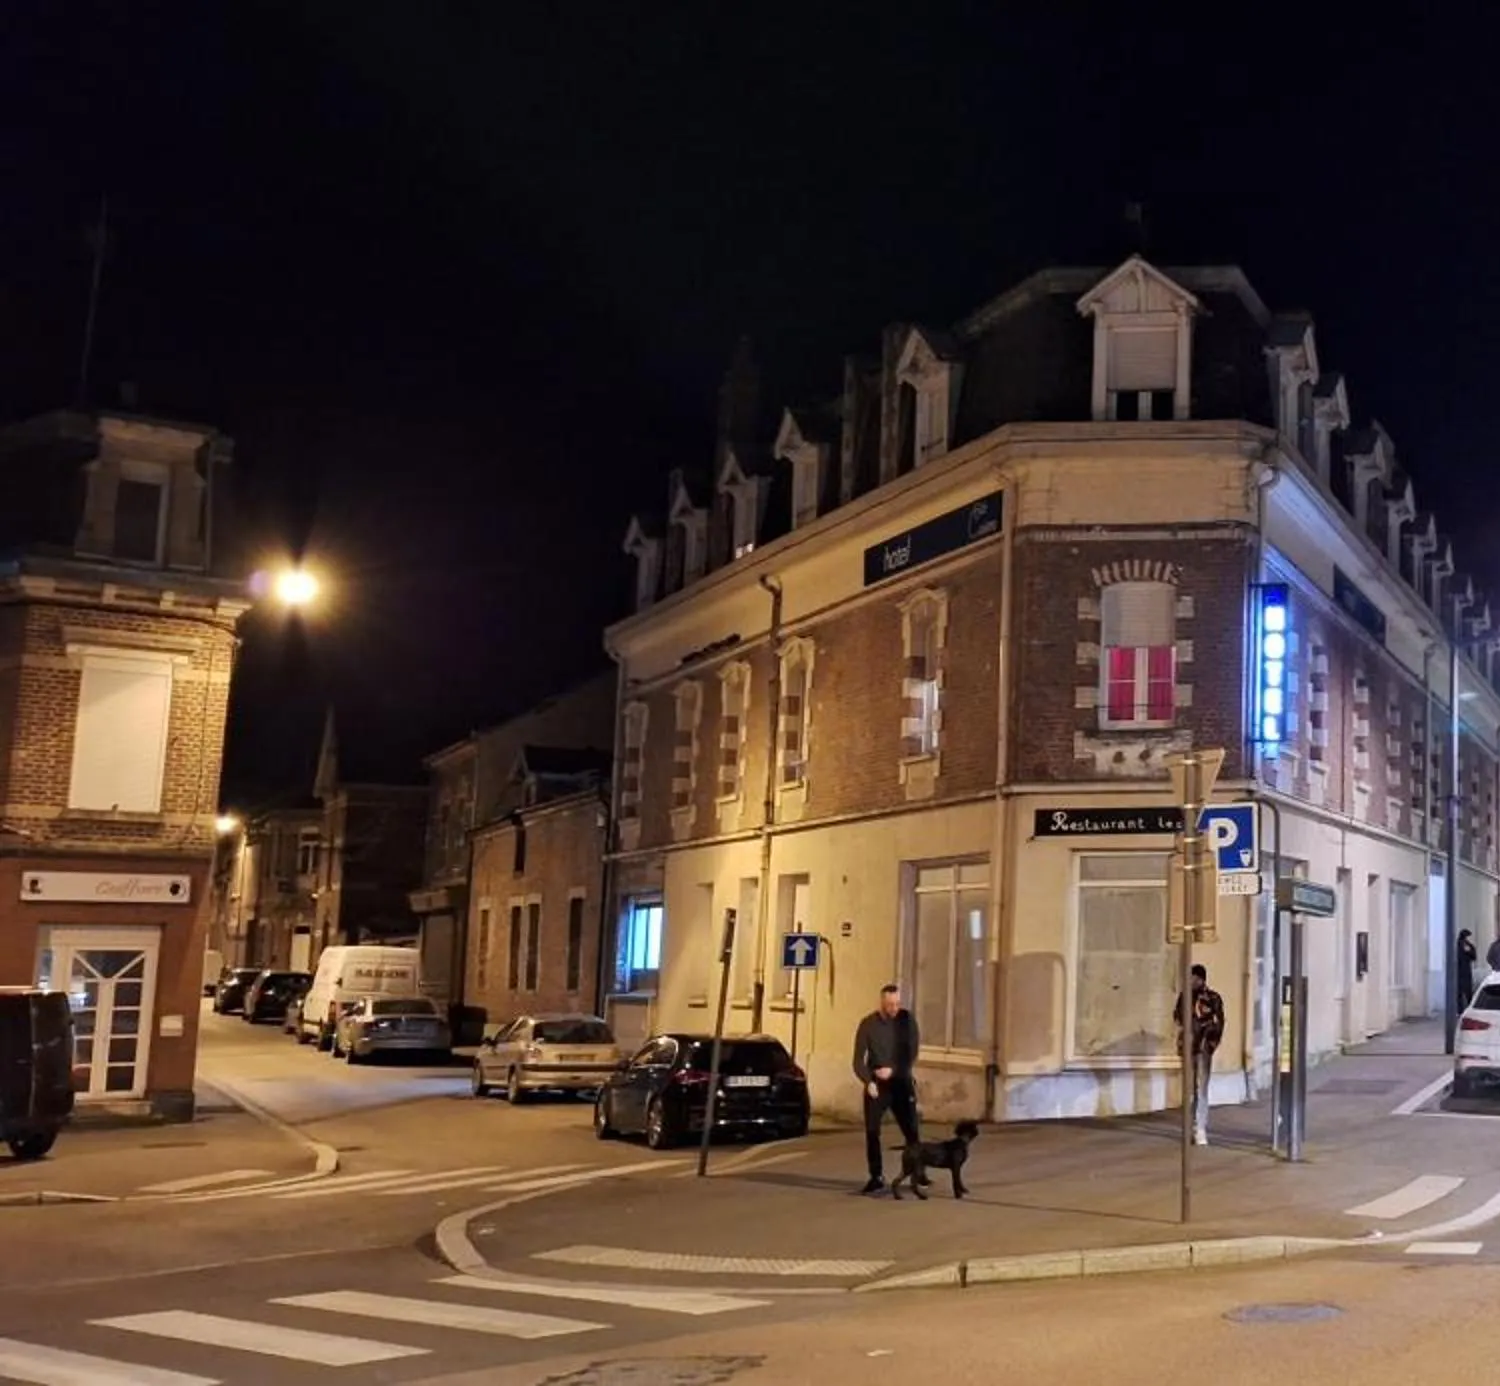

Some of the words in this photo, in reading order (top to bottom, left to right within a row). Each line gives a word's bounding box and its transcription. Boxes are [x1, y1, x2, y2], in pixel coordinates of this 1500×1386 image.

[1263, 605, 1286, 741] HOTEL
[1050, 811, 1145, 832] Restaurant
[1208, 817, 1239, 851] P
